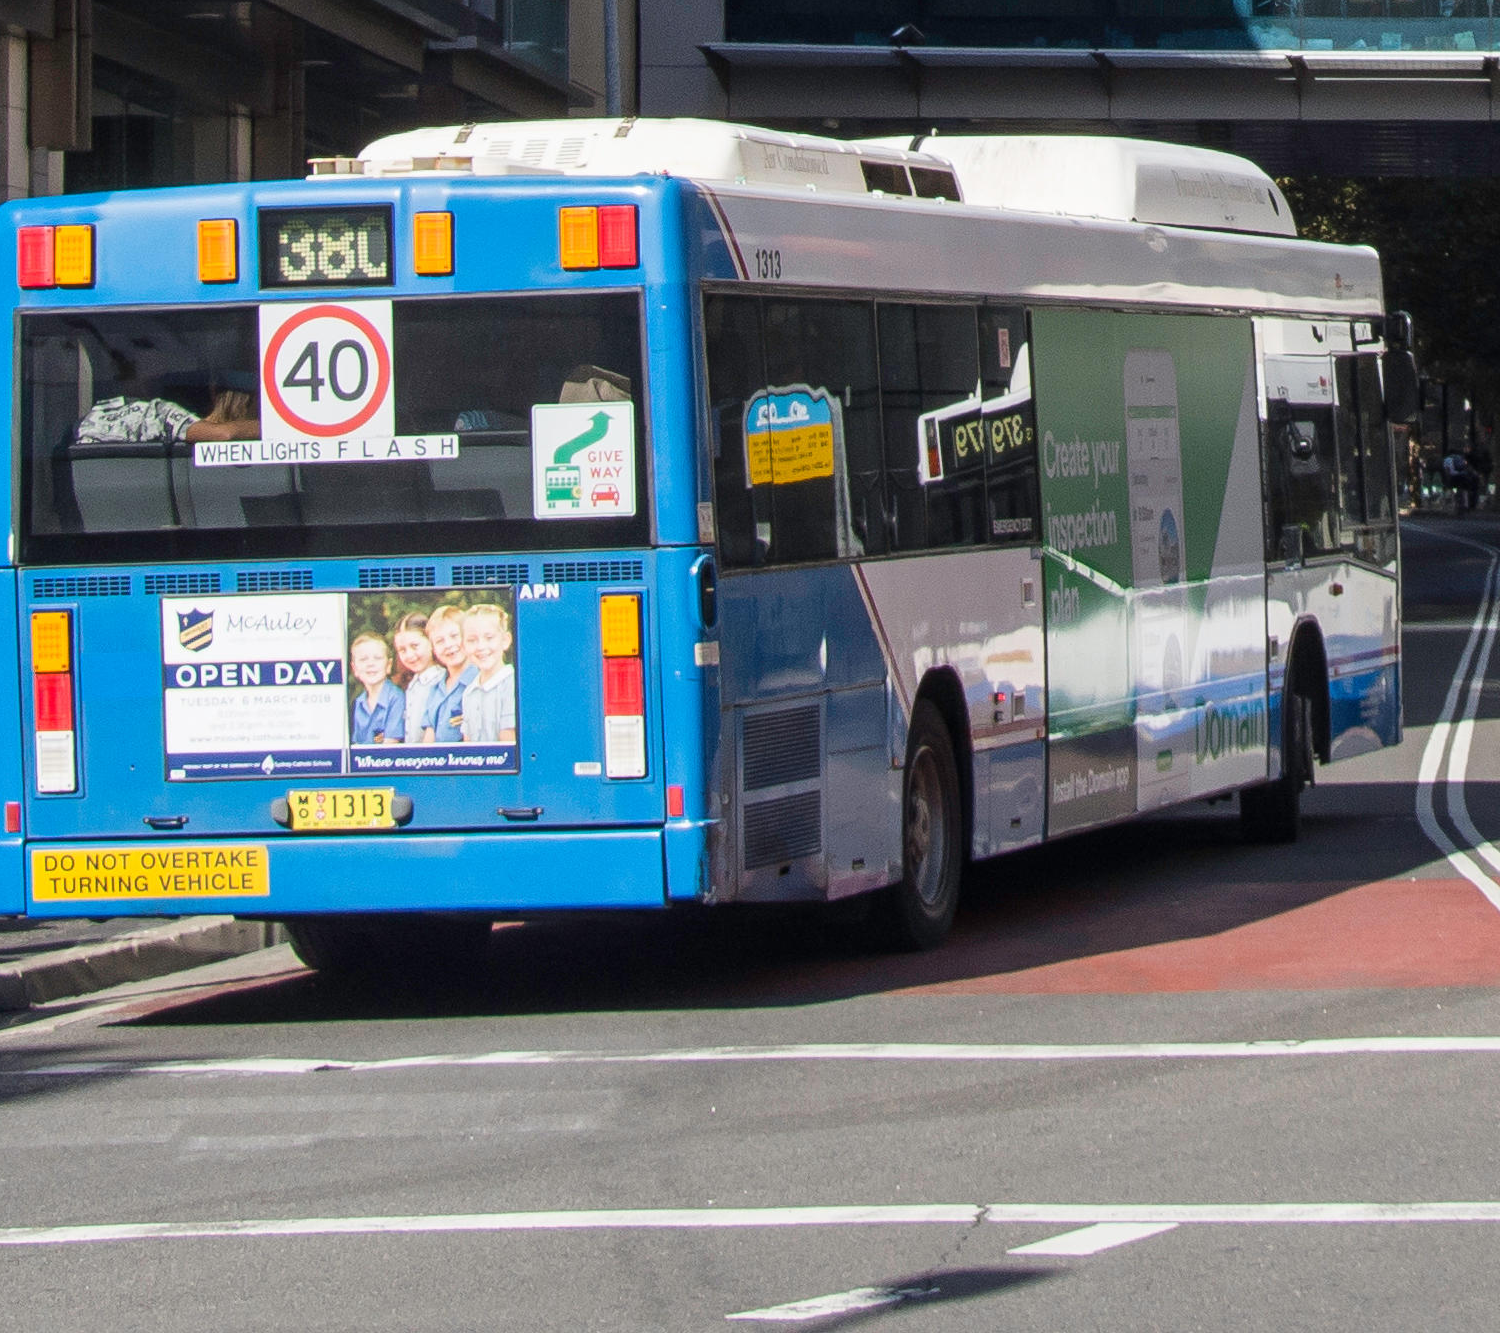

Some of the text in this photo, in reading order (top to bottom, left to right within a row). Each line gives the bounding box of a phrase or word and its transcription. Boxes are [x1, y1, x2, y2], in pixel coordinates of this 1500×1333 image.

[755, 248, 782, 279] 1313
[282, 339, 369, 403] 40
[200, 444, 253, 463] WHEN
[260, 441, 321, 461] LIGHTS
[587, 451, 625, 462] GIVE
[1043, 430, 1120, 489] Create your
[590, 466, 623, 479] WAY
[1048, 497, 1118, 559] inspection
[519, 583, 560, 600] APN
[175, 660, 336, 687] OPEN DAY
[181, 696, 236, 706] TUESDAY
[254, 694, 299, 705] MARCH
[302, 693, 332, 704] 2018
[1195, 694, 1266, 765] Domain
[1088, 763, 1116, 794] Domain
[332, 793, 385, 818] 1313
[44, 849, 259, 872] DO NOT OVERTAKE
[49, 872, 254, 894] TURNING VEHICLE
